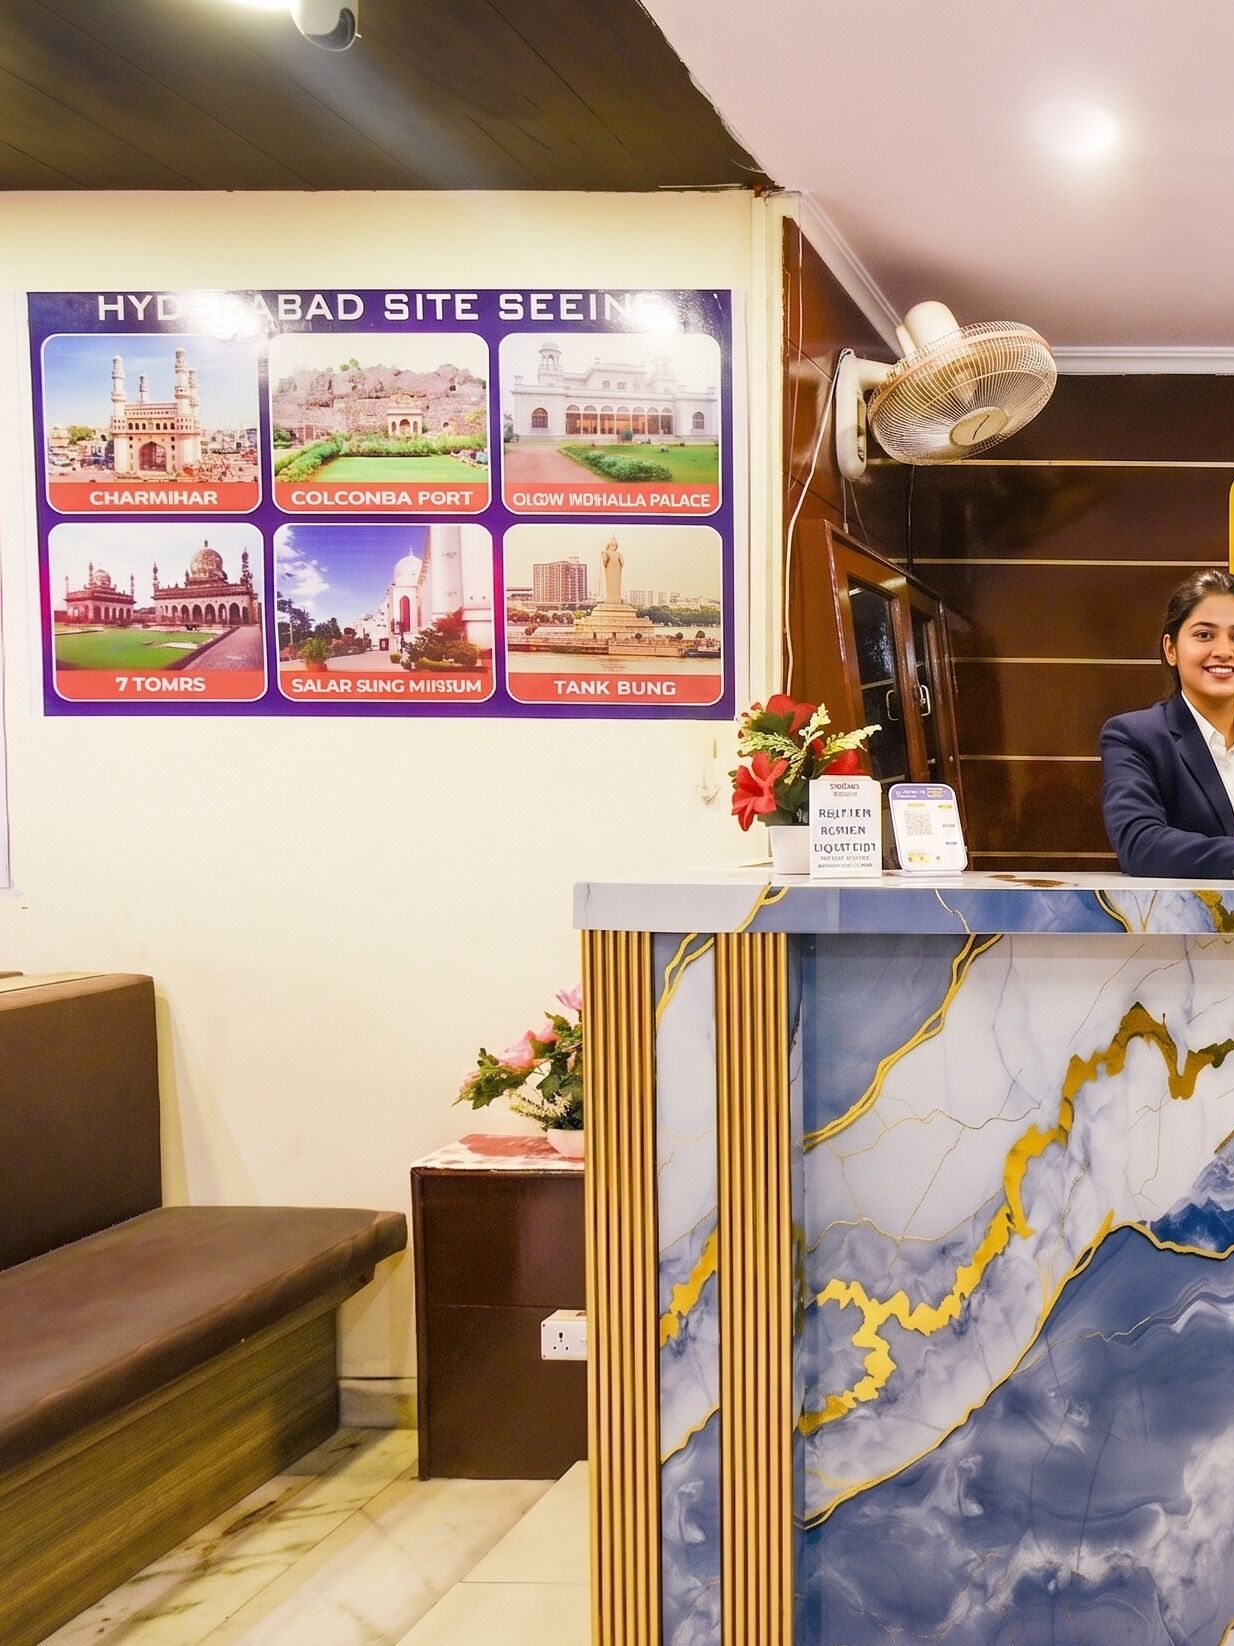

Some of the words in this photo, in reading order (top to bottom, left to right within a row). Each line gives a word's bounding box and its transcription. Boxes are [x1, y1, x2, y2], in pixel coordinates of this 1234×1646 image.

[98, 294, 364, 321] HYDABAD
[384, 293, 479, 321] SITE
[89, 491, 218, 505] CHARMIHAR
[650, 494, 711, 508] PALACE
[115, 676, 129, 692] 7
[132, 676, 206, 692] TOMRS
[291, 678, 352, 693] SALAR
[553, 680, 610, 695] TANK
[617, 681, 676, 696] BUNG
